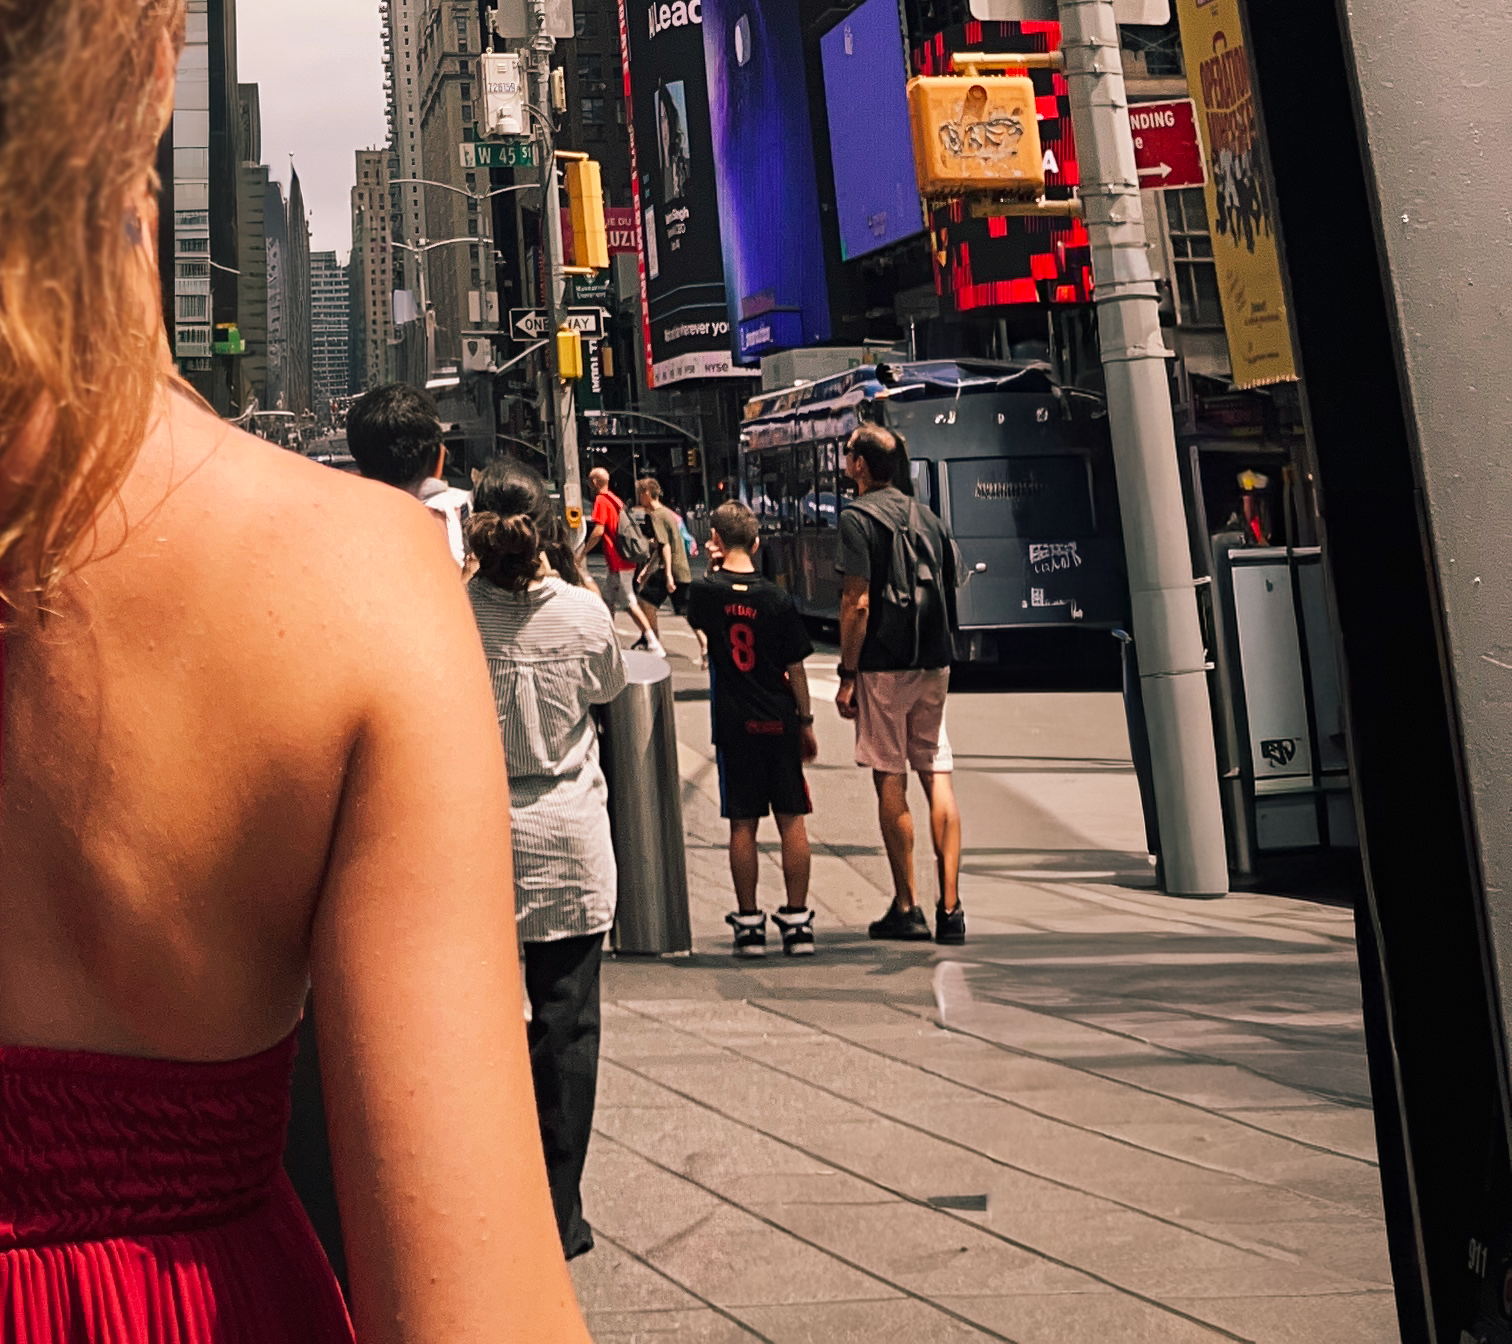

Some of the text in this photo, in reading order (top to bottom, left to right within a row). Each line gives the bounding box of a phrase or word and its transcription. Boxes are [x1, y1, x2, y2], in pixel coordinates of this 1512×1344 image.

[478, 146, 491, 164] W
[498, 146, 516, 165] 45
[524, 318, 549, 331] ONE
[729, 622, 756, 673] 8
